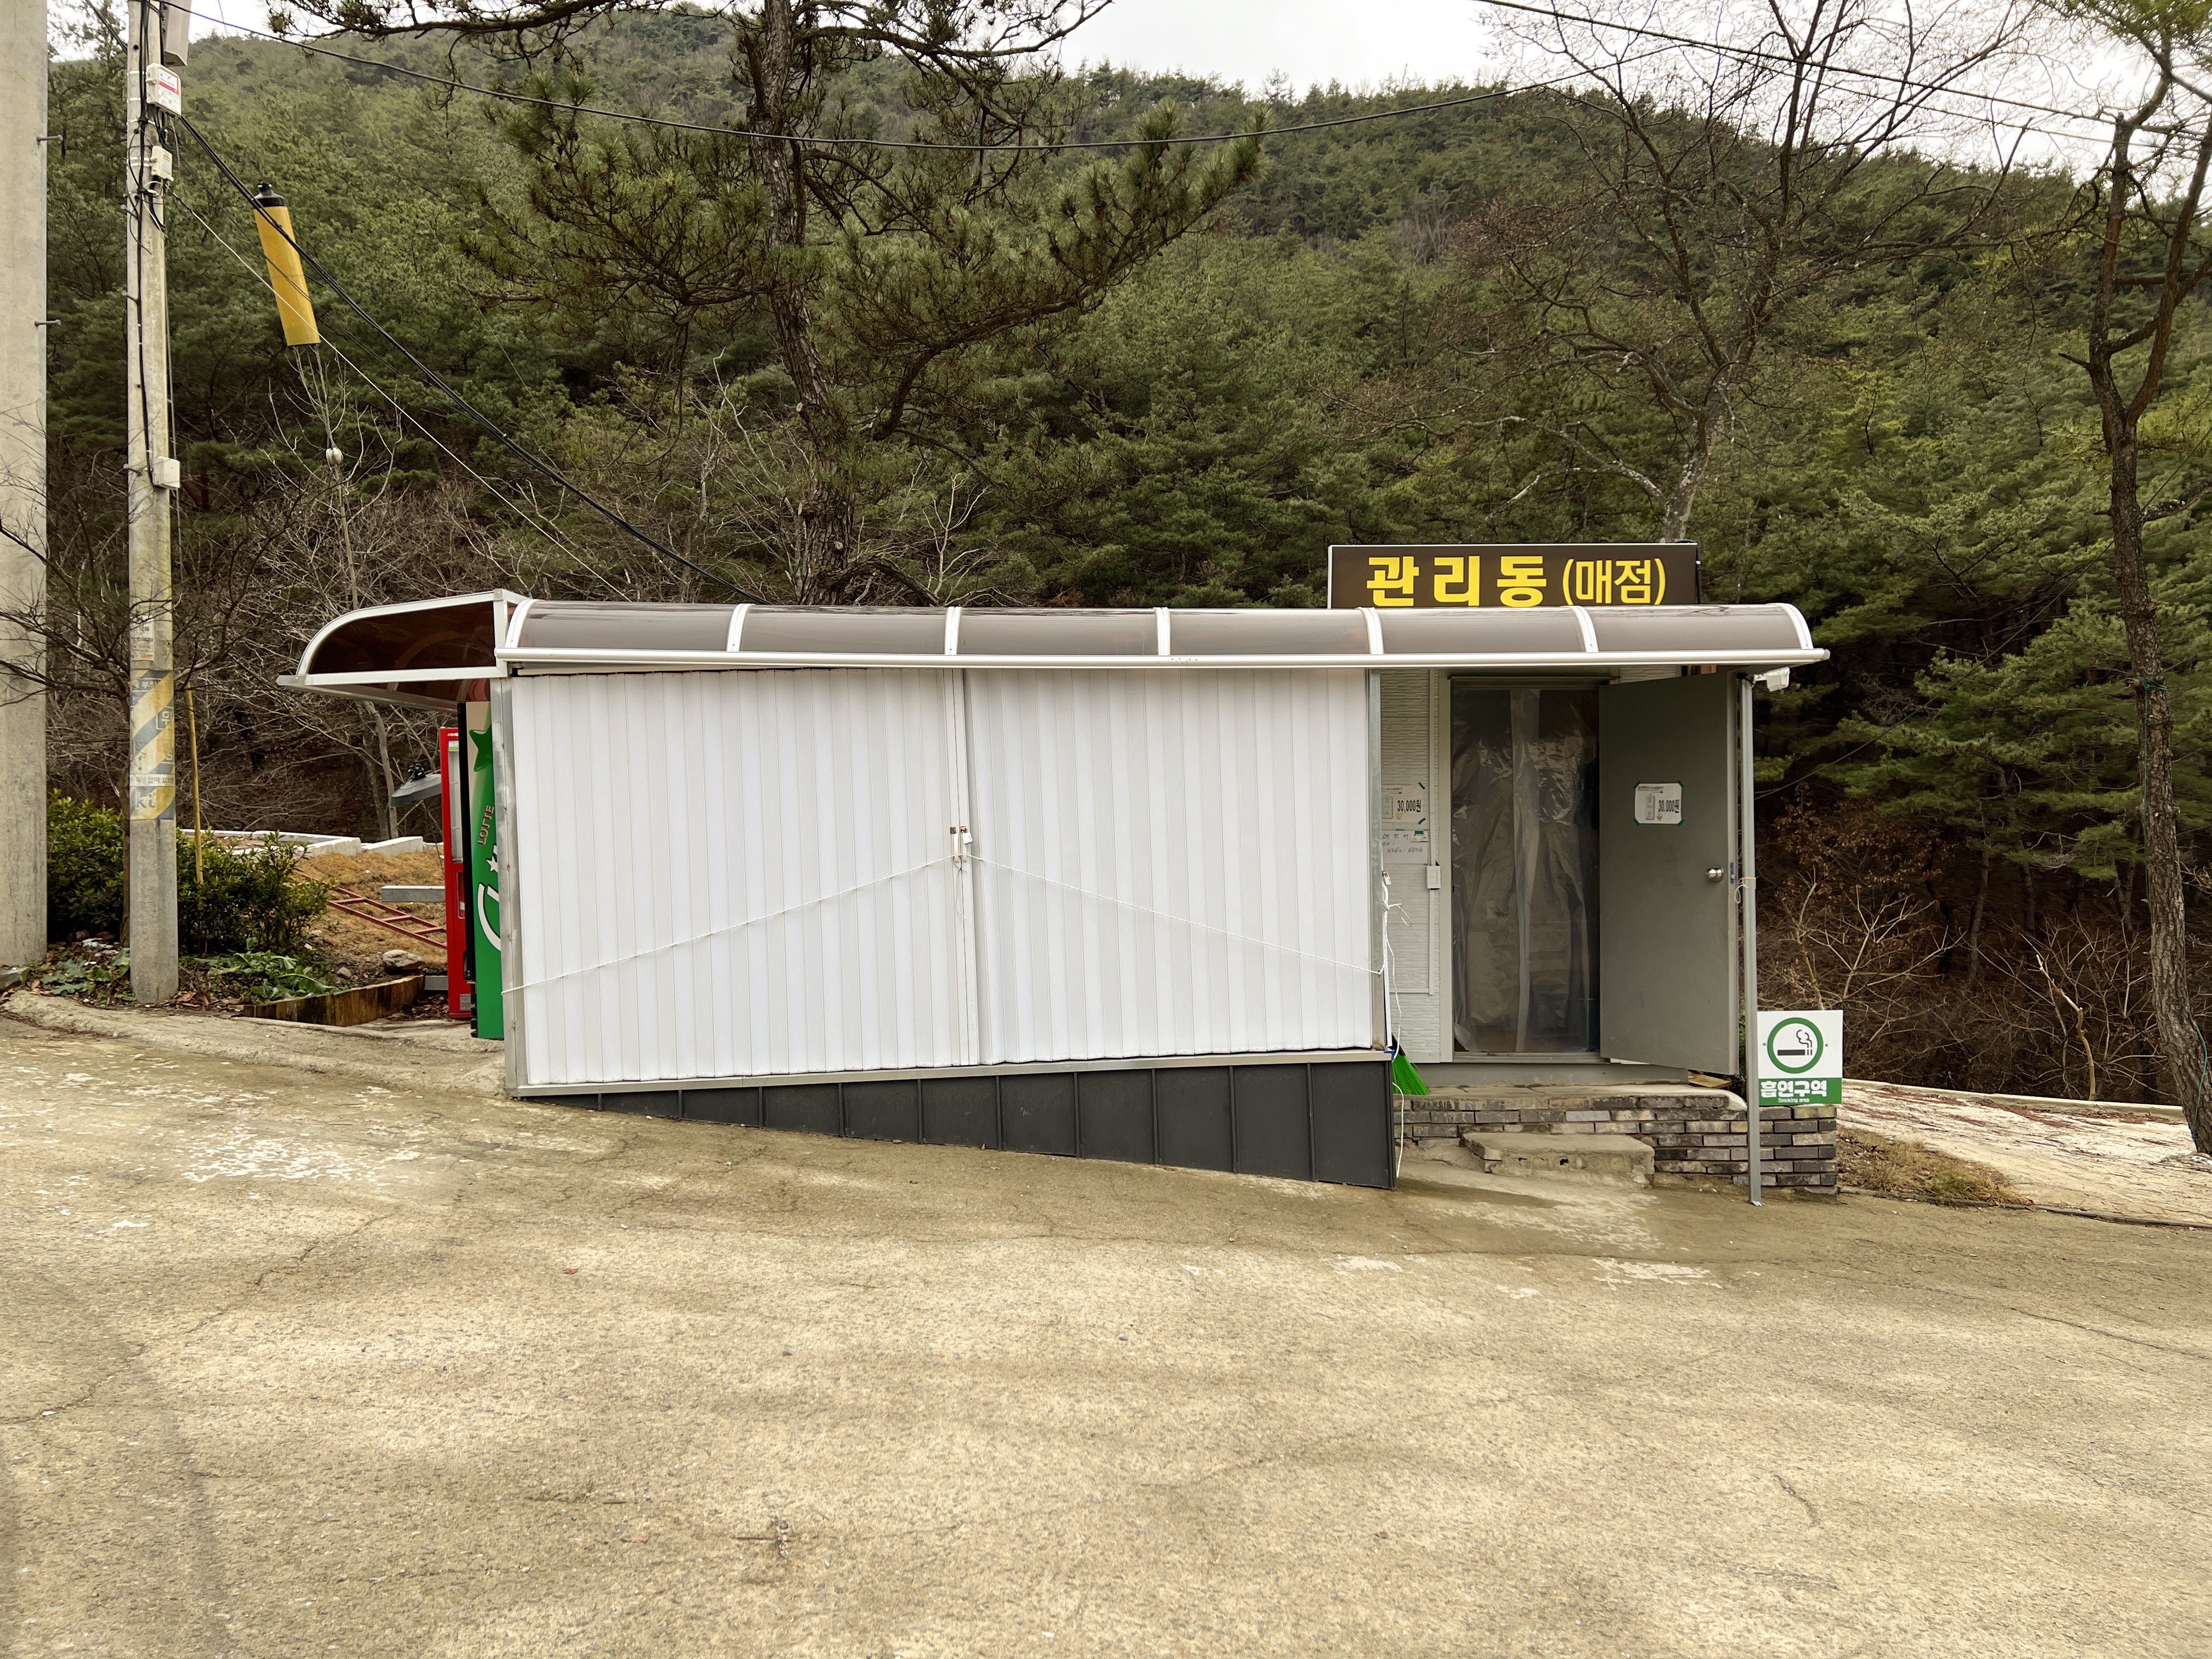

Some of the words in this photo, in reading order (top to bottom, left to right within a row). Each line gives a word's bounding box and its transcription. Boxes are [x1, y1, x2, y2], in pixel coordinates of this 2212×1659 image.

[1397, 799, 1421, 813] 30,000원
[477, 805, 494, 845] LOTTE
[1760, 1080, 1827, 1098] 흡연구역
